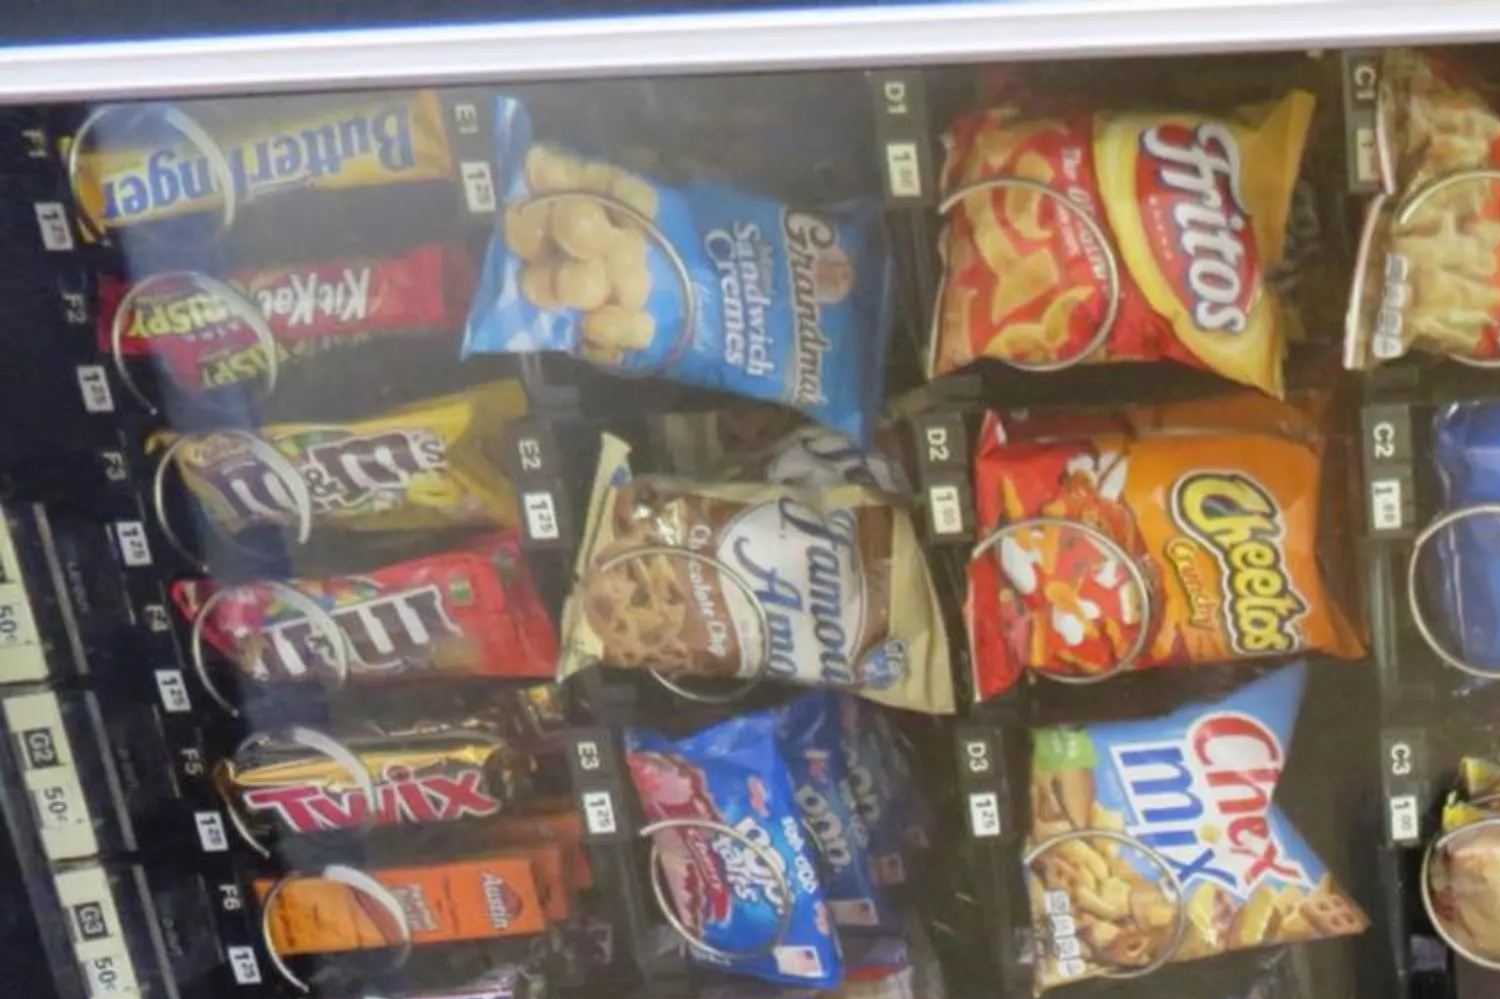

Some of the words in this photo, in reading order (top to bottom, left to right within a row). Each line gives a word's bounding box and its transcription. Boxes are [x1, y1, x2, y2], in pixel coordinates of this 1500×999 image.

[884, 81, 907, 114] D1
[1353, 65, 1376, 100] C1
[455, 104, 477, 133] E1
[22, 129, 47, 160] F1
[98, 106, 417, 222] Butterfnger
[1141, 122, 1248, 334] Fritos
[61, 293, 87, 325] F2
[703, 228, 749, 370] Cremes
[732, 221, 777, 377] Sandwich
[127, 294, 232, 340] RISPY
[517, 439, 541, 472] E2
[927, 428, 949, 463] D2
[1373, 422, 1395, 459] C2
[102, 451, 126, 481] F3
[1176, 473, 1307, 654] Cheetos
[778, 496, 856, 684] Famou
[1164, 537, 1220, 634] Crunchy
[143, 604, 168, 632] F4
[733, 536, 804, 678] Amo
[27, 731, 53, 766] G2
[180, 748, 202, 776] F5
[578, 742, 599, 770] E3
[967, 742, 987, 772] D3
[1391, 743, 1411, 776] C3
[1192, 714, 1303, 888] Chex
[219, 883, 240, 911] F6
[479, 871, 511, 930] Austin
[81, 905, 103, 935] G3
